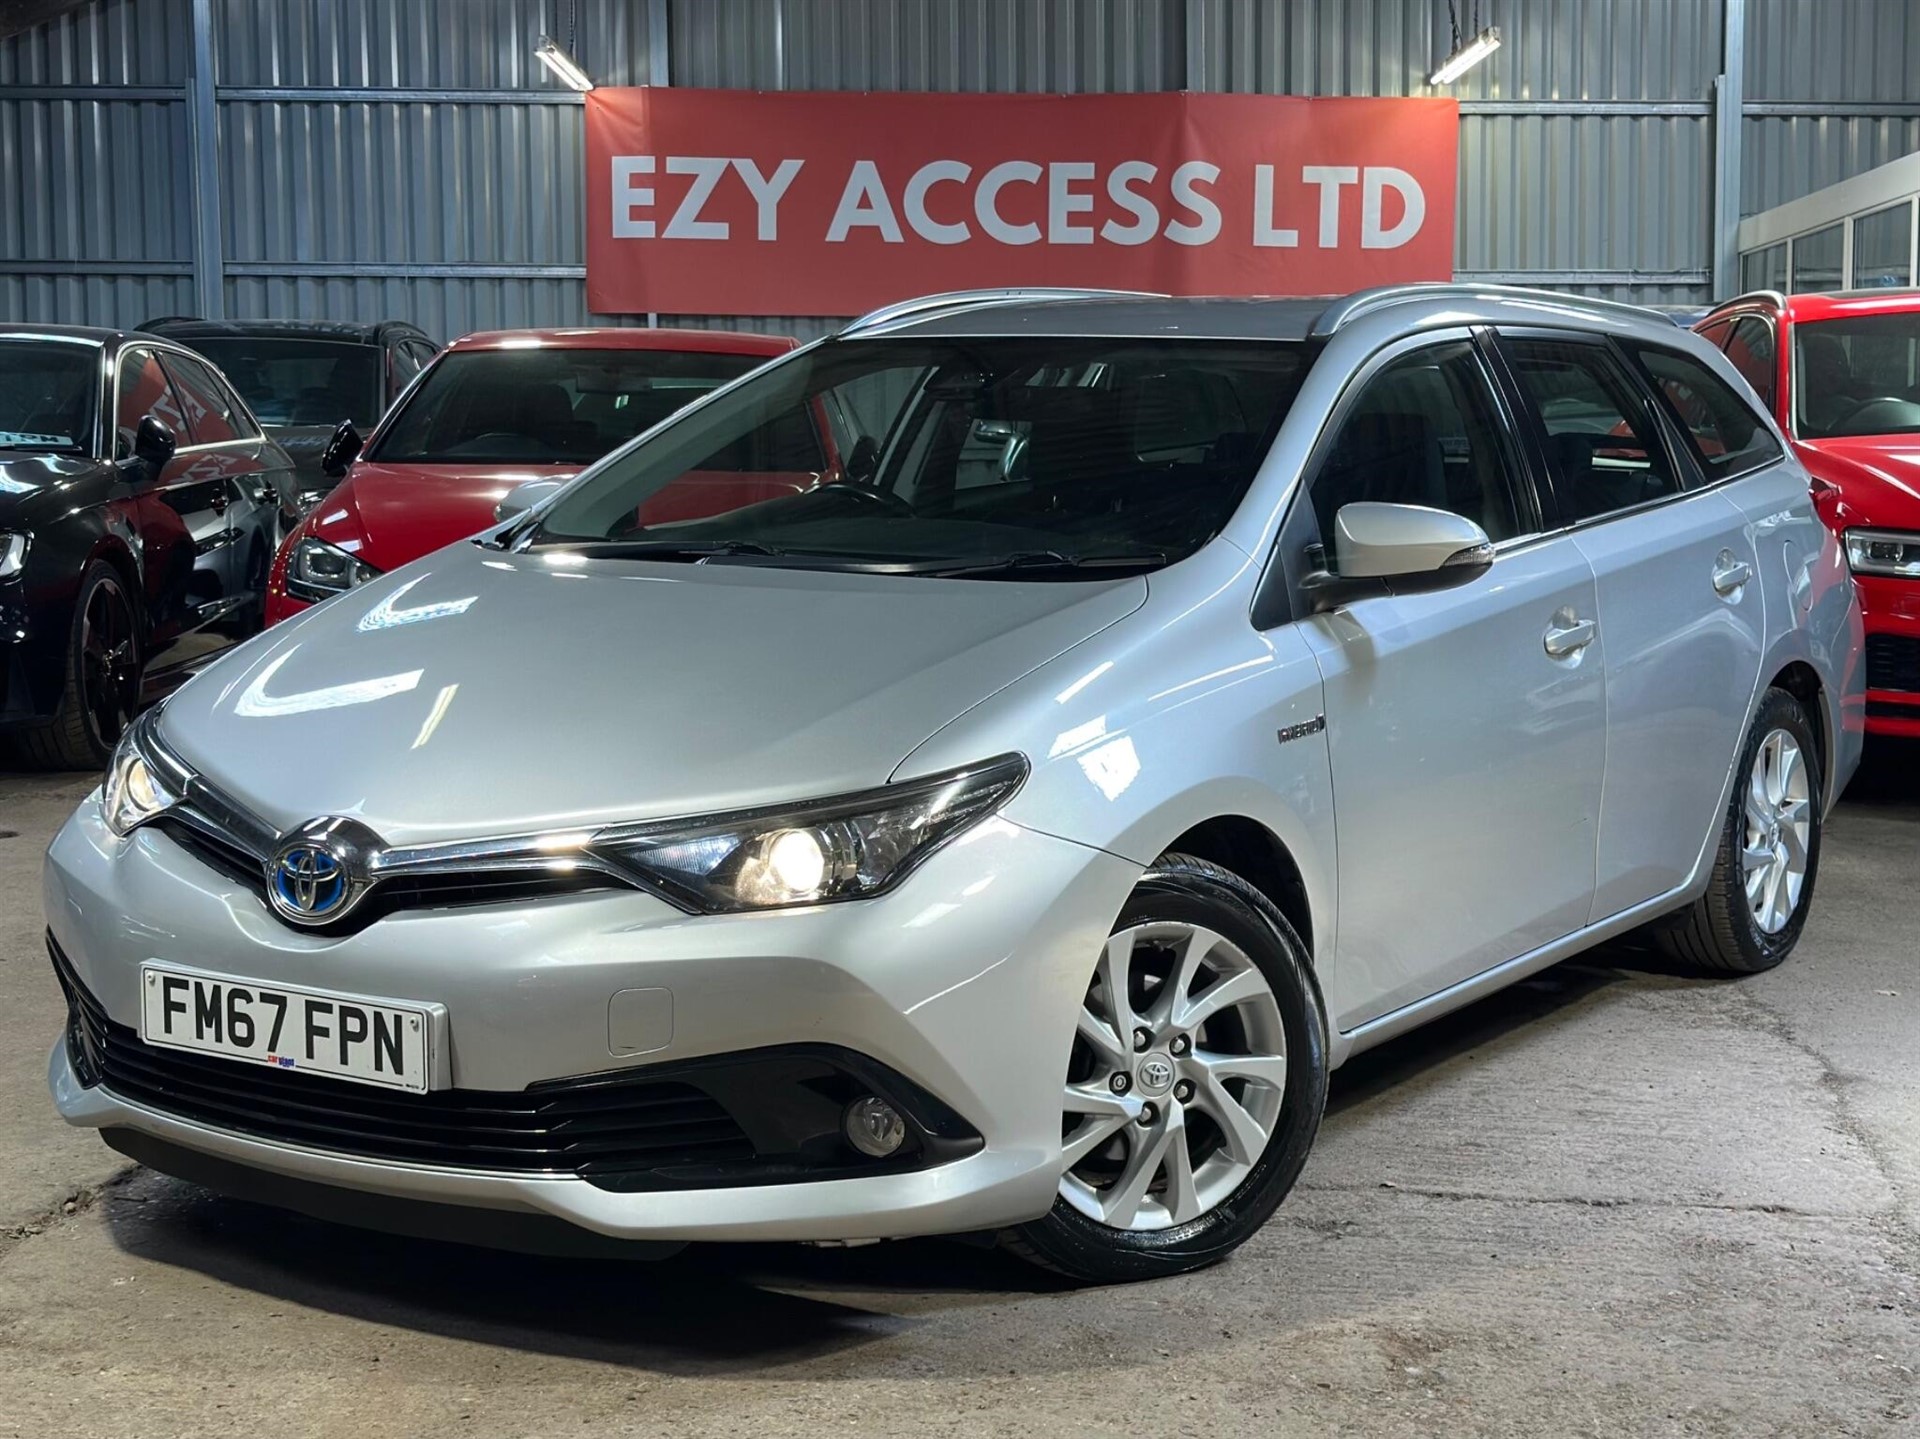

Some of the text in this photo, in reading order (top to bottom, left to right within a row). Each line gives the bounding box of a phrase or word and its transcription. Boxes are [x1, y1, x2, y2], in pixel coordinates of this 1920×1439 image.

[612, 156, 1426, 249] EZY ACCESS LTD
[162, 975, 404, 1076] FM67 FPN
